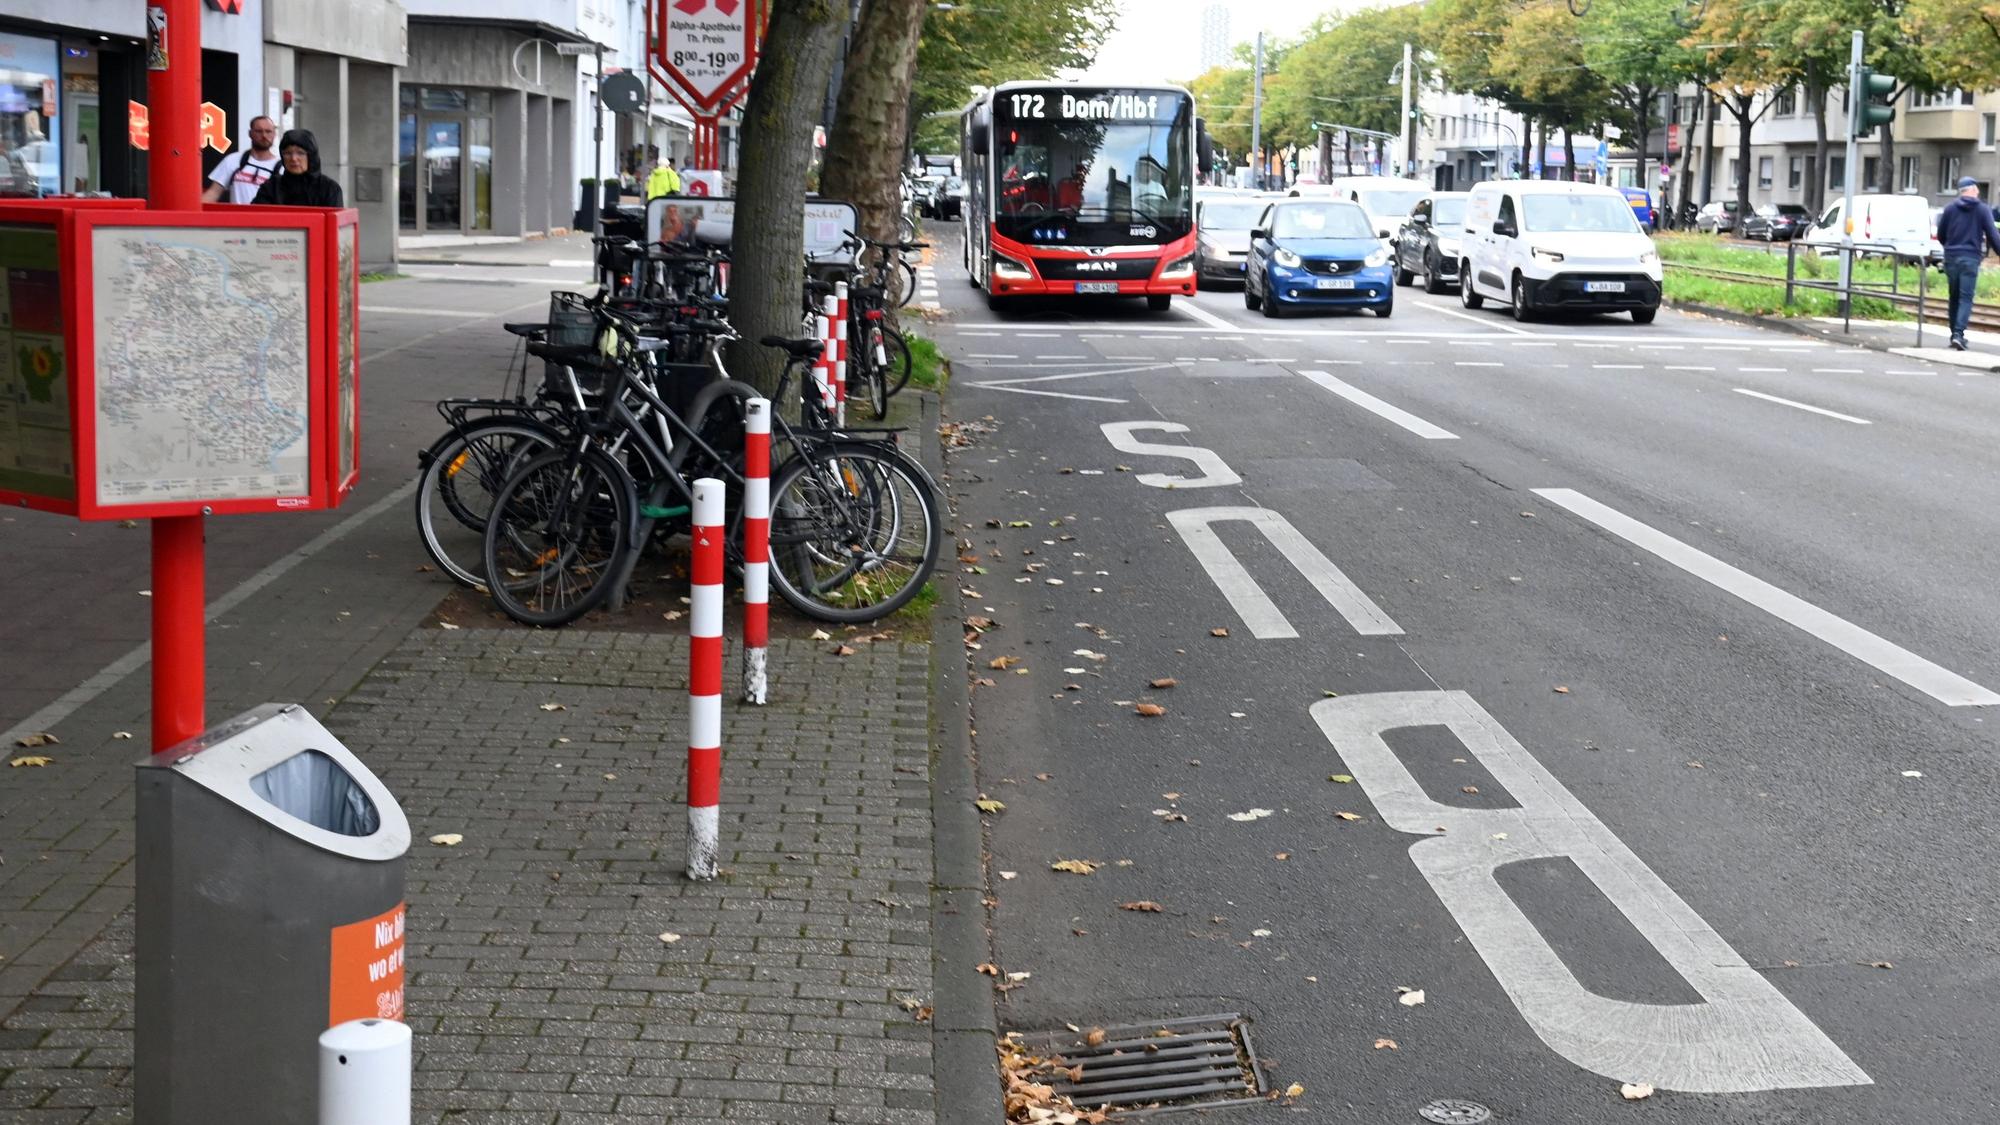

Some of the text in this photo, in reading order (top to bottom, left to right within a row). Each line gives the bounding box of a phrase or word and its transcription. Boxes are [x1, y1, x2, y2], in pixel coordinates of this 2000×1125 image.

[670, 21, 742, 31] Alpha-Apotheke
[687, 34, 725, 43] Th. Preis
[1011, 94, 1157, 118] 172 Dom/Hbf
[1076, 261, 1118, 272] MAN
[375, 921, 394, 949] Nix
[368, 957, 387, 982] wo
